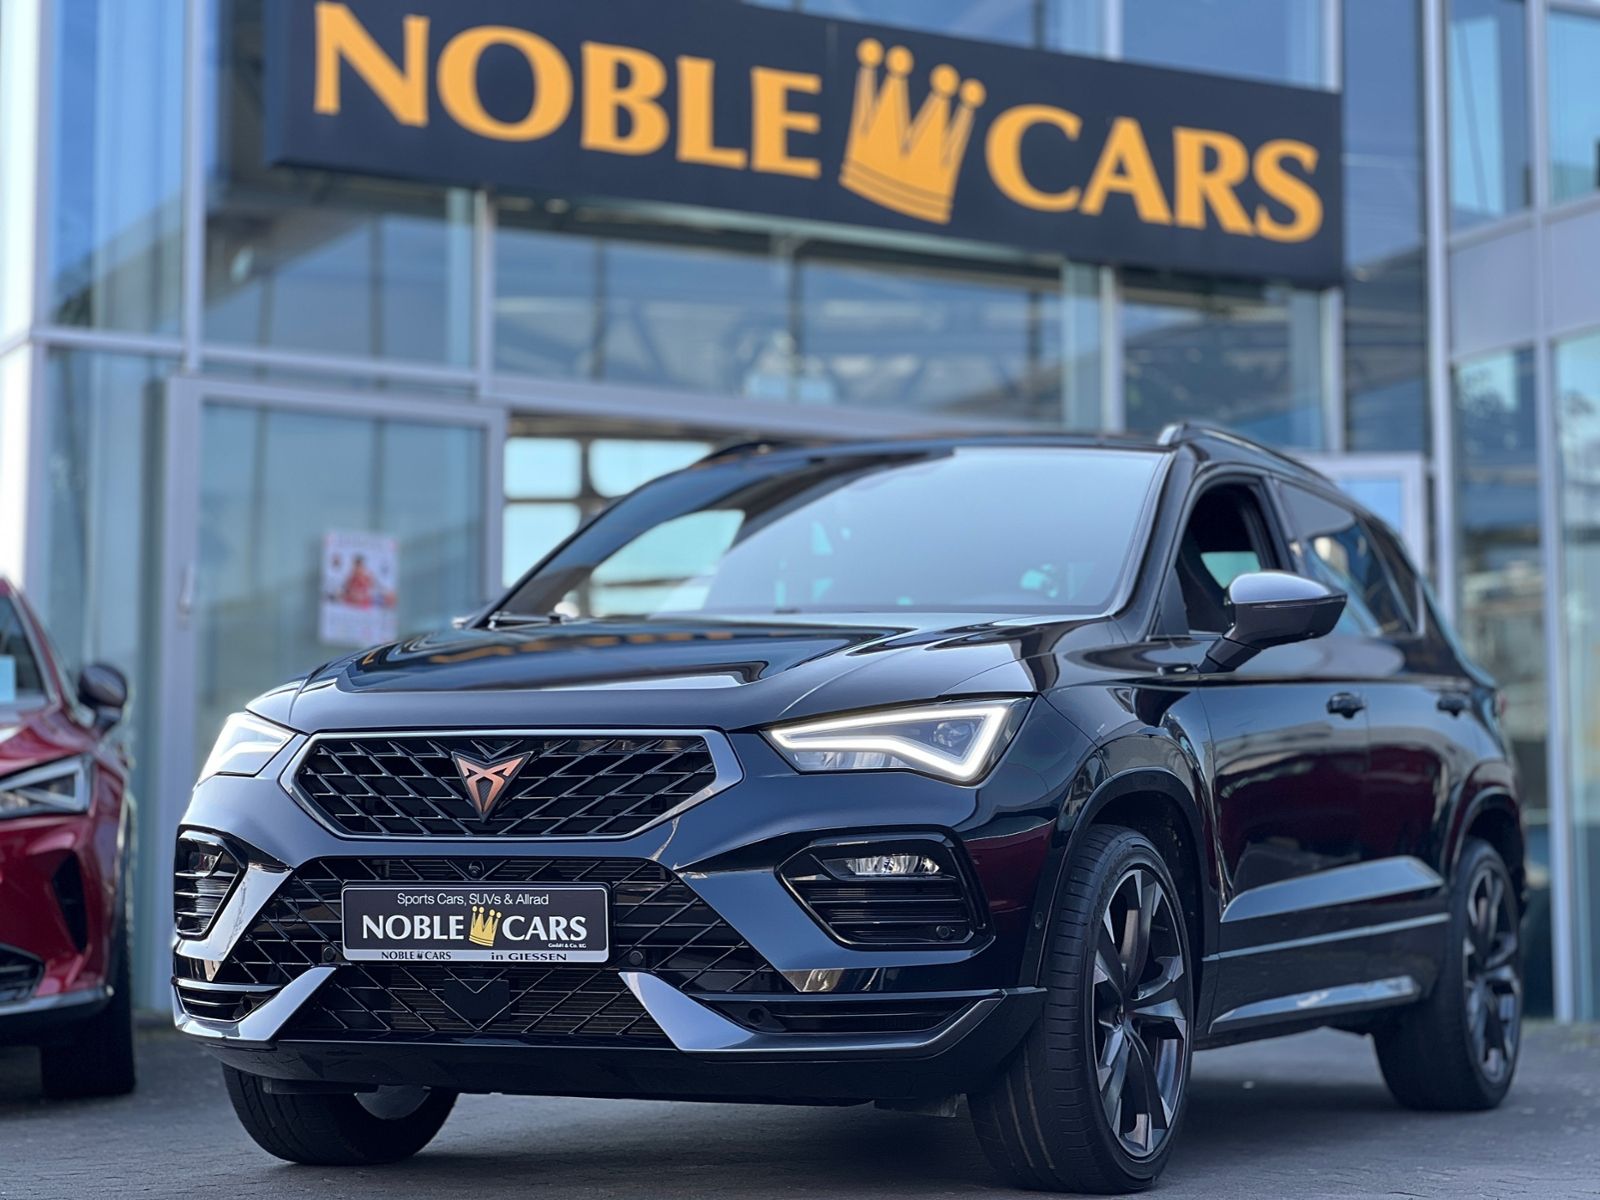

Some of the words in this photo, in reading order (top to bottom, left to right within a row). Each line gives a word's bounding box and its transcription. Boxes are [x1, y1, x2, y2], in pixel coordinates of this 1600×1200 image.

[313, 1, 822, 179] NOBLE
[985, 103, 1324, 243] CARS
[397, 892, 435, 906] Sports
[437, 892, 467, 906] Cars,
[469, 893, 502, 905] SUVs
[503, 893, 513, 905] &
[515, 893, 549, 905] Allrad
[362, 914, 465, 940] NOBLE
[501, 915, 588, 941] CARS
[381, 950, 415, 960] NOBLE
[424, 950, 452, 960] CARS
[491, 951, 504, 961] in
[508, 952, 567, 961] GIESSEN
